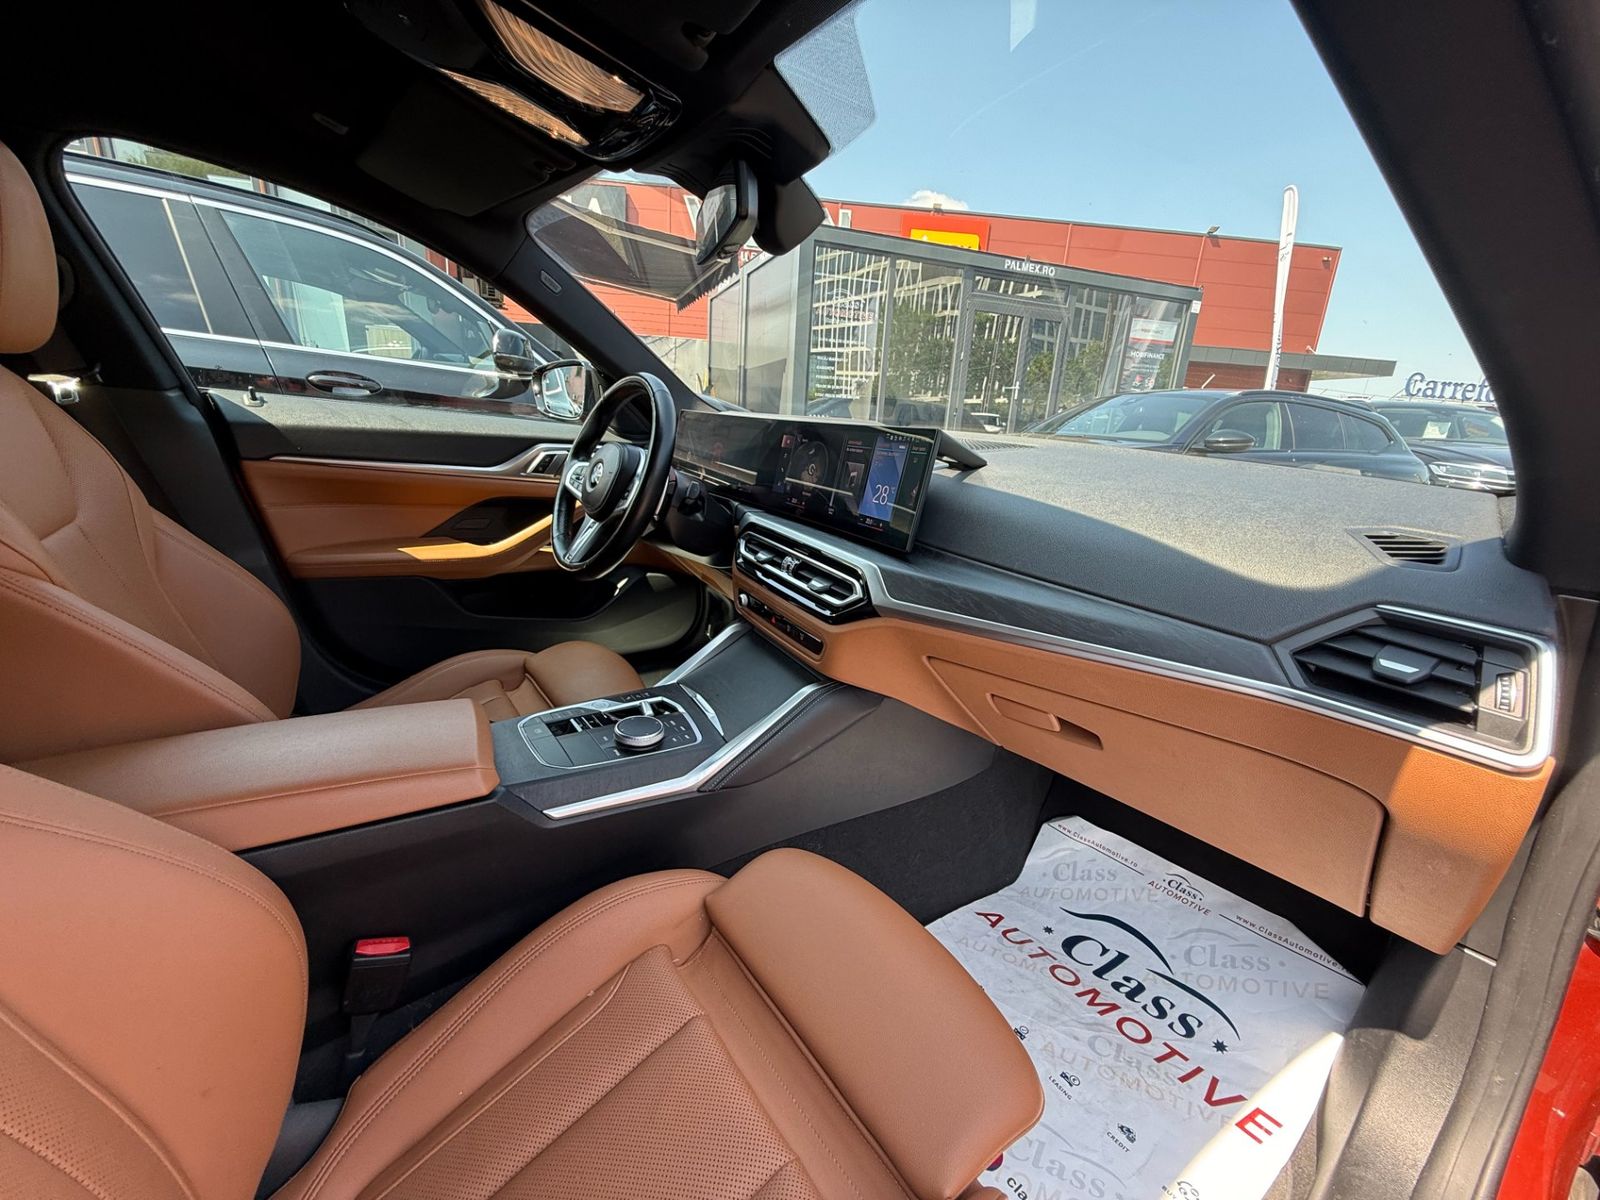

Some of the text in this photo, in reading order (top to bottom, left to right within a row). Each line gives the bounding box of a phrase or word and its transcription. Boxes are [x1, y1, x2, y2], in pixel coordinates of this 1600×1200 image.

[1004, 258, 1056, 277] PALMEX.RO
[872, 484, 890, 505] 28
[1057, 823, 1139, 868] www.ClassAutomotive.ro
[1052, 861, 1119, 882] Class
[1147, 879, 1212, 916] AUTOMOTIVE
[1167, 878, 1199, 900] Class
[1235, 913, 1346, 972] www.ClassAutomotive.r
[1183, 943, 1271, 972] Class
[1061, 935, 1204, 1039] Class
[1143, 971, 1329, 1000] ATOMOTIVE
[974, 911, 1284, 1145] AUTOMOTIVE
[1048, 1075, 1072, 1100] LEASING
[1106, 1131, 1131, 1153] CREDIT
[1009, 1135, 1106, 1199] Class
